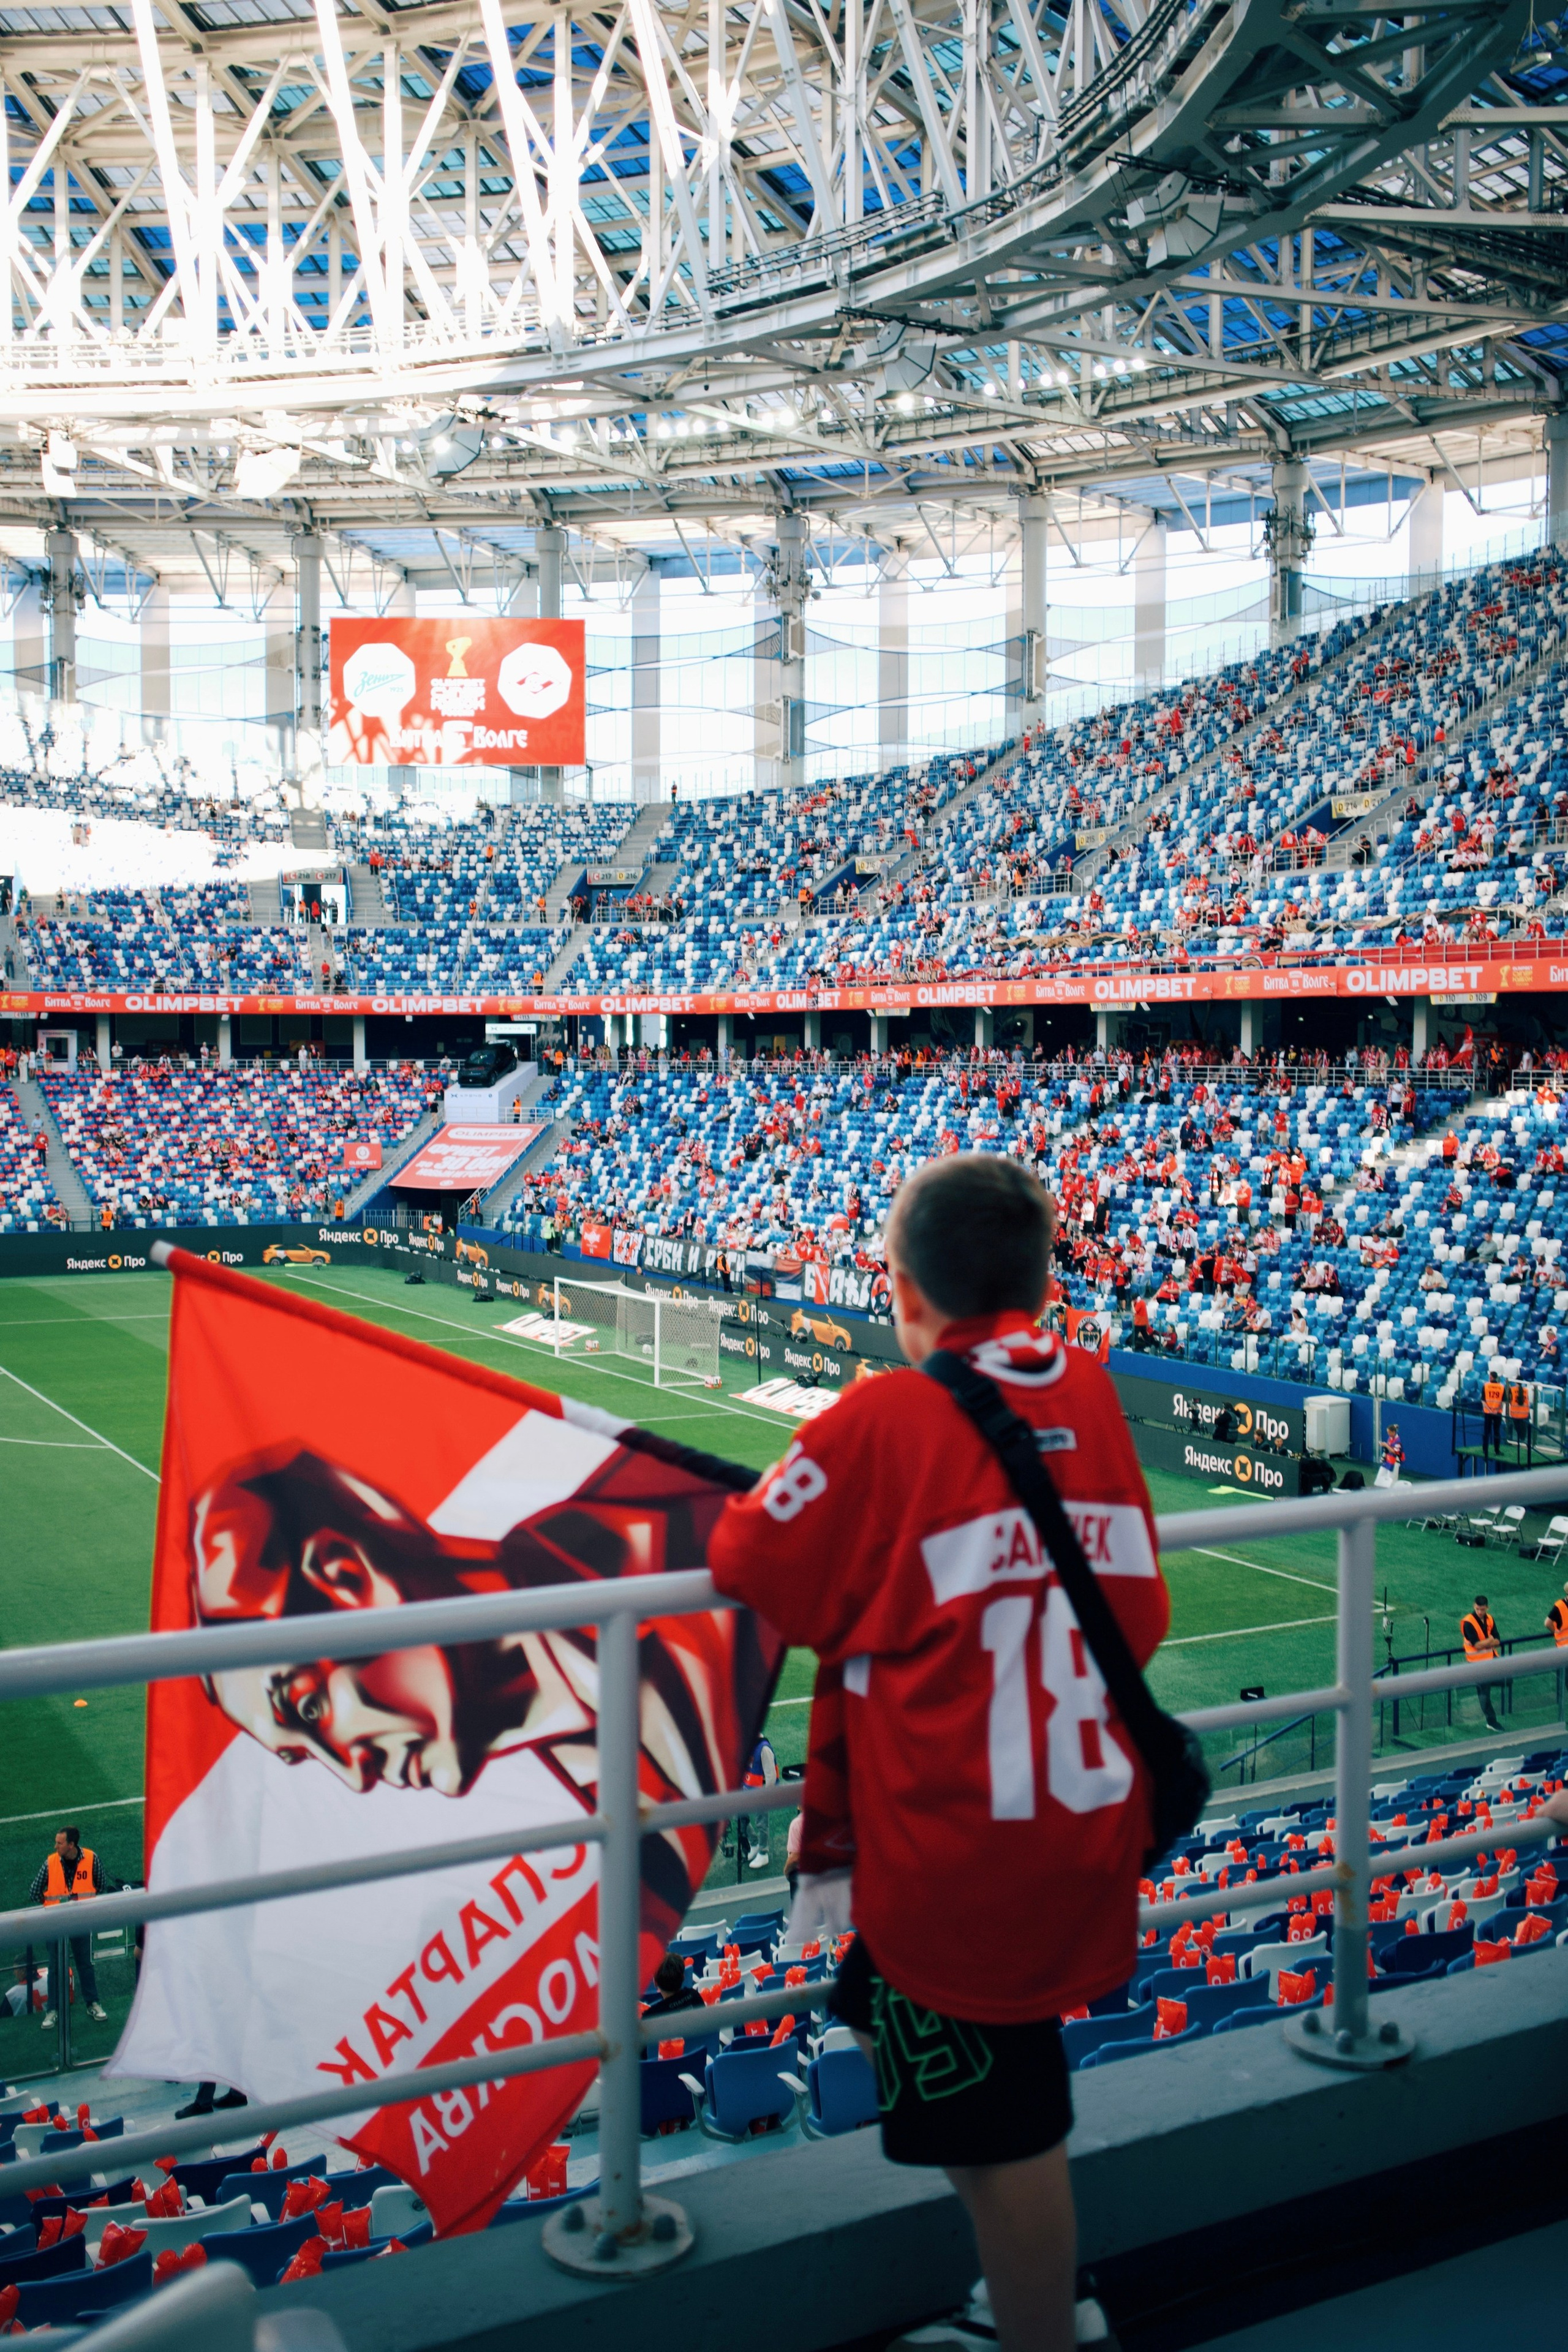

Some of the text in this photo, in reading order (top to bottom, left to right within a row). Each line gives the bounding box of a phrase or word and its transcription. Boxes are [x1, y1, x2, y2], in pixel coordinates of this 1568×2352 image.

[1095, 978, 1196, 1000] OLIMPBET
[1347, 966, 1483, 992] OLIMPBET
[125, 996, 244, 1012] OLIMPBET
[776, 991, 841, 1009] OLIMBET
[918, 984, 997, 1004] OLIMPBET
[1446, 994, 1456, 1003] 110
[371, 998, 486, 1012] OLIMPBET
[601, 997, 693, 1012] OLIMPBET
[318, 1228, 399, 1245] Яндекс Про
[409, 1232, 444, 1252] Яндекс Про
[67, 1256, 146, 1270] Яндекс Про
[222, 1251, 243, 1264] Про
[687, 1245, 699, 1273] И
[457, 1269, 488, 1289] Яндекс Про
[496, 1278, 529, 1298] Яндекс Про
[645, 1283, 672, 1300] Яндекс
[720, 1333, 745, 1353] Яндекс
[785, 1348, 840, 1376] Яндекс Про
[742, 1378, 842, 1419] OLIMPB
[1256, 1410, 1289, 1440] Про
[1185, 1446, 1283, 1487] Яндекс Про
[980, 1588, 1134, 1821] 18
[77, 1871, 88, 1881] 50
